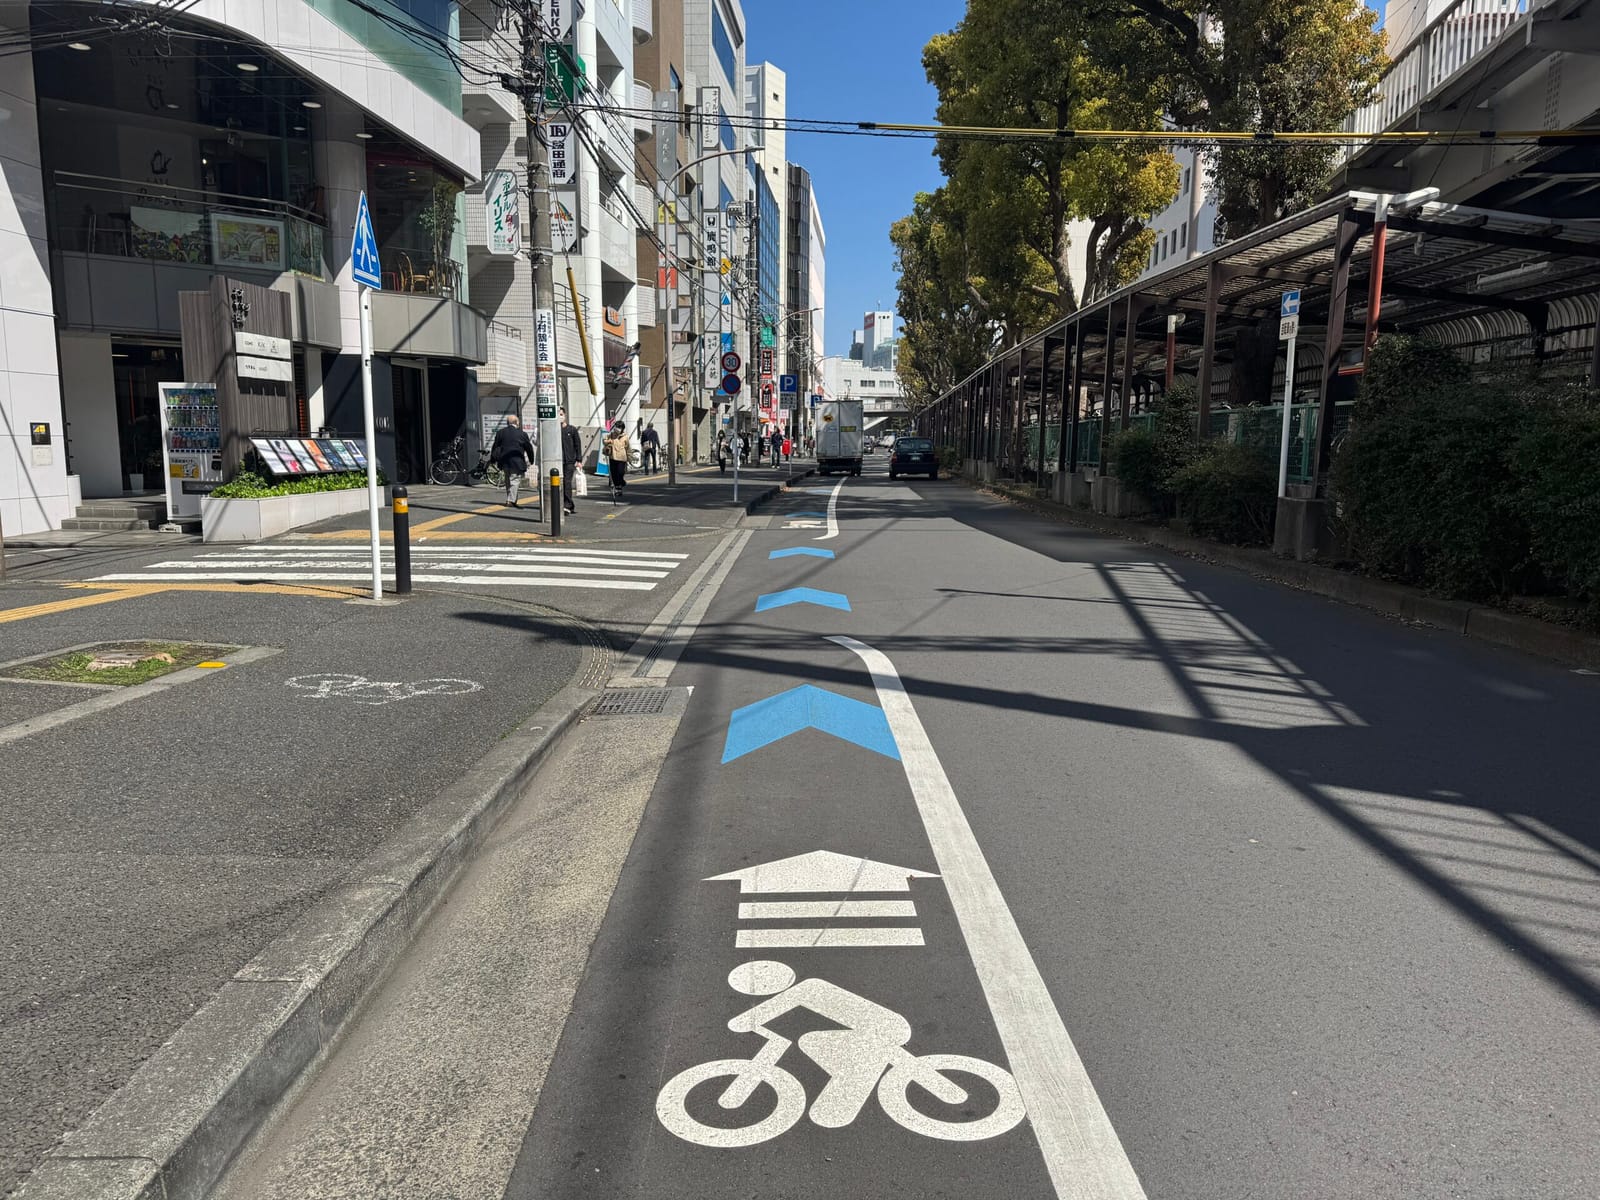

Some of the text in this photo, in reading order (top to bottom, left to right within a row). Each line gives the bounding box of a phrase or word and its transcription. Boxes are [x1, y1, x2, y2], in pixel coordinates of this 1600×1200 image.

[493, 194, 503, 233] イリス
[726, 357, 737, 367] 30
[784, 376, 794, 390] P
